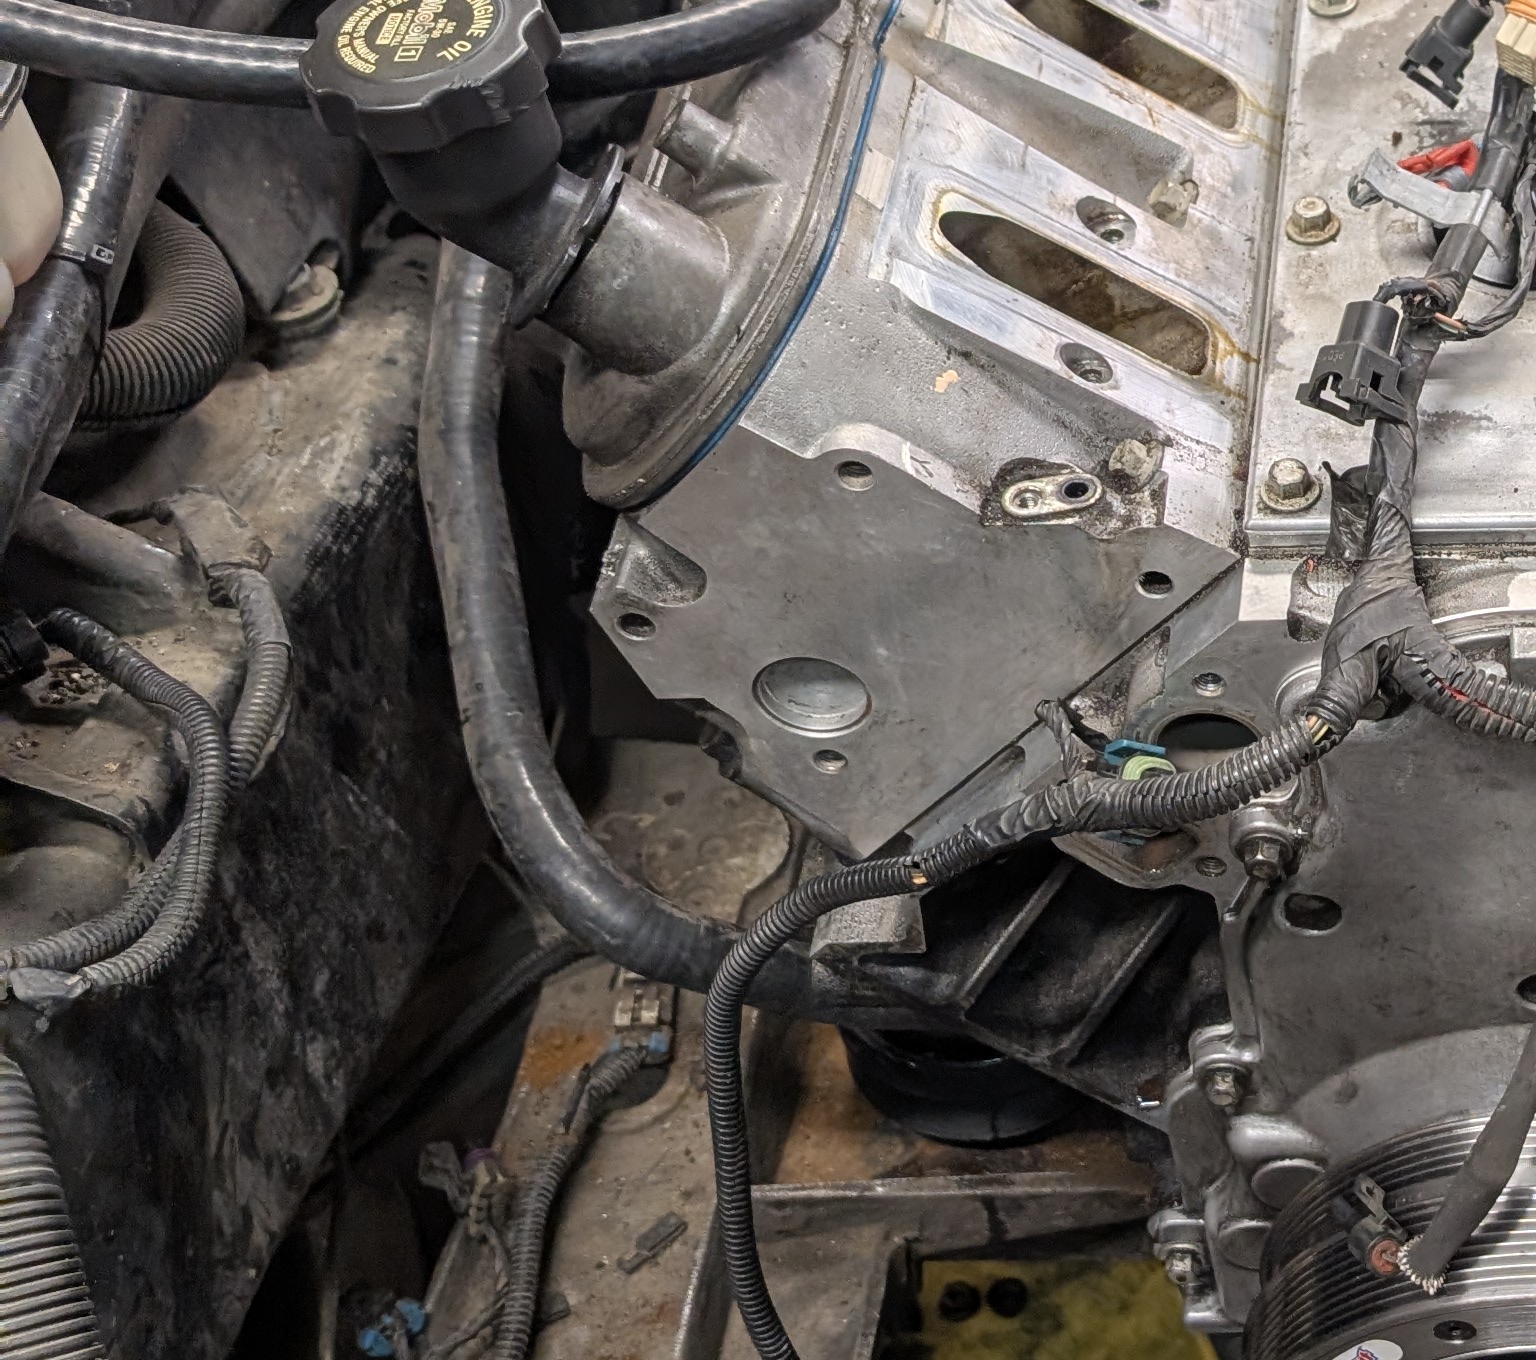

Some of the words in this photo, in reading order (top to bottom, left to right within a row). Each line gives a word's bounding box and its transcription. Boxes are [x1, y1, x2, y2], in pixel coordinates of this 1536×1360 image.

[340, 6, 370, 33] ENGINE
[379, 15, 400, 41] NOTICE
[340, 46, 376, 73] REQUIRED
[353, 38, 380, 63] MANUAL
[436, 41, 472, 61] OIL
